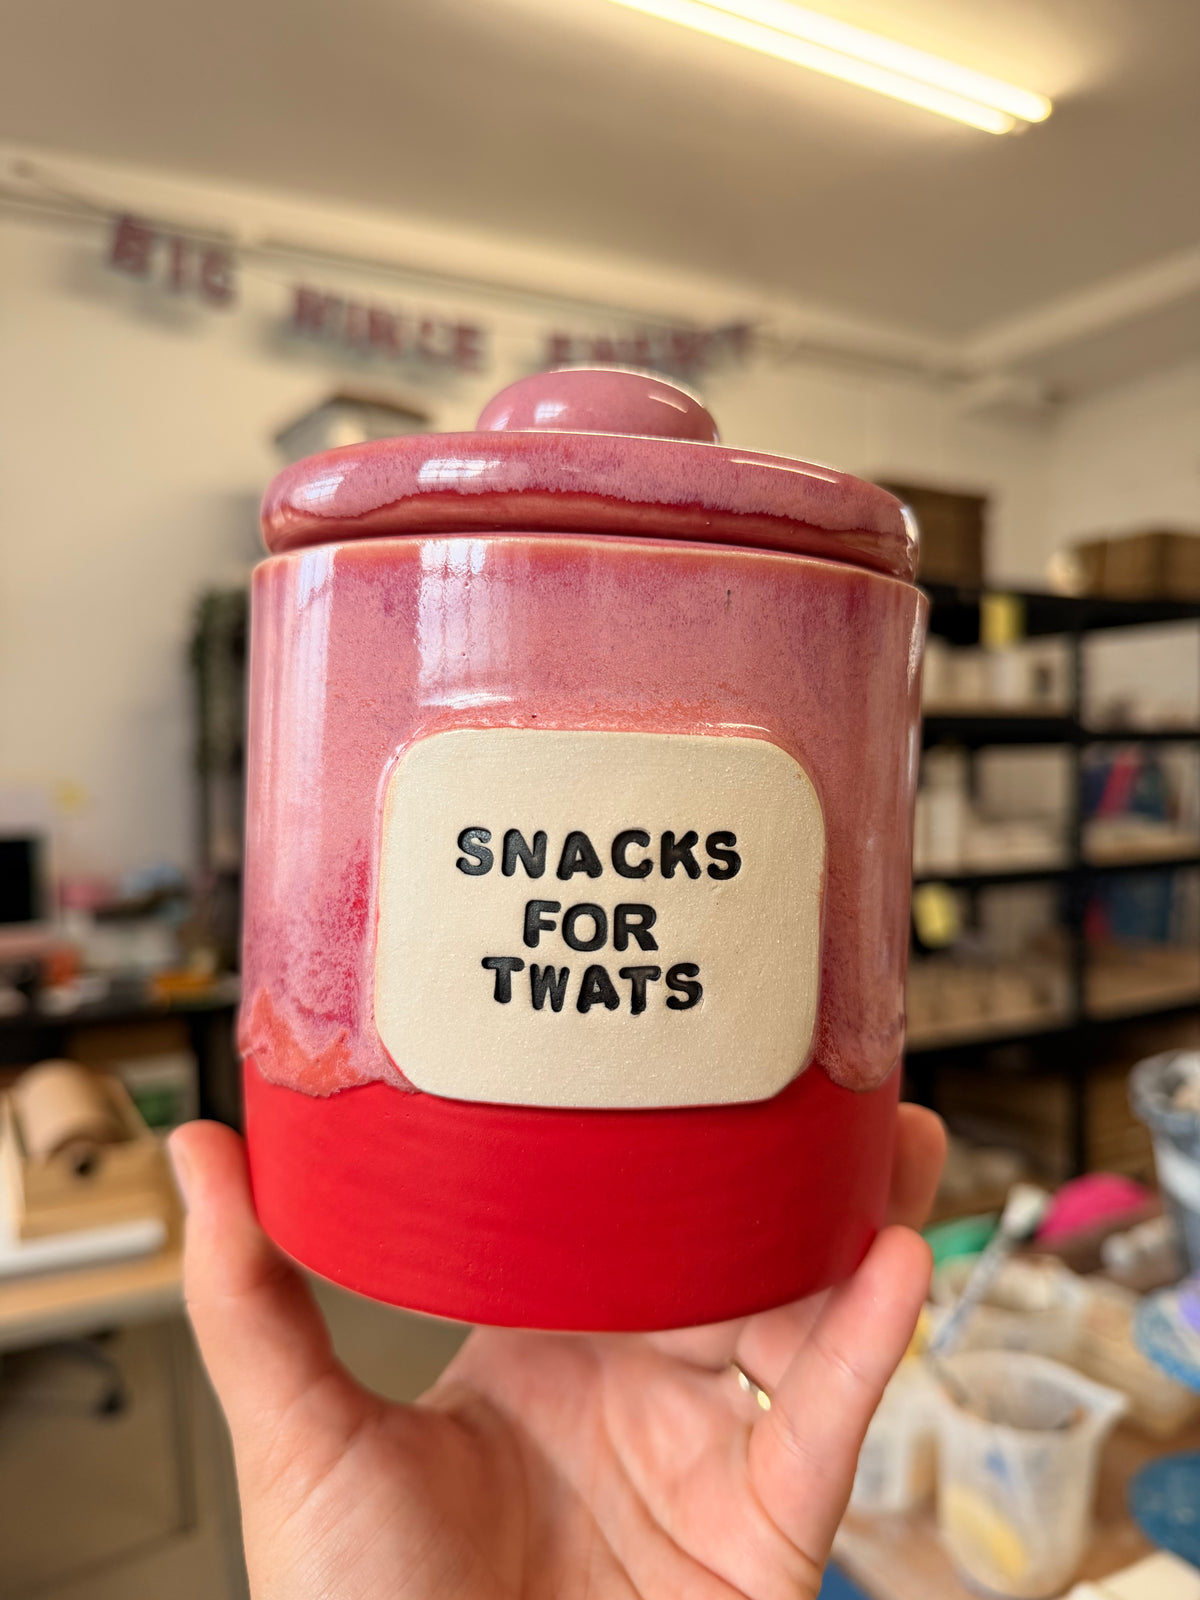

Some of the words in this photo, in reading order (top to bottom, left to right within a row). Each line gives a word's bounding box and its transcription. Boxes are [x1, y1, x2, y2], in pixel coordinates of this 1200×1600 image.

[455, 826, 742, 881] SNACKS
[522, 899, 659, 953] FOR
[480, 956, 704, 1016] TWATS
